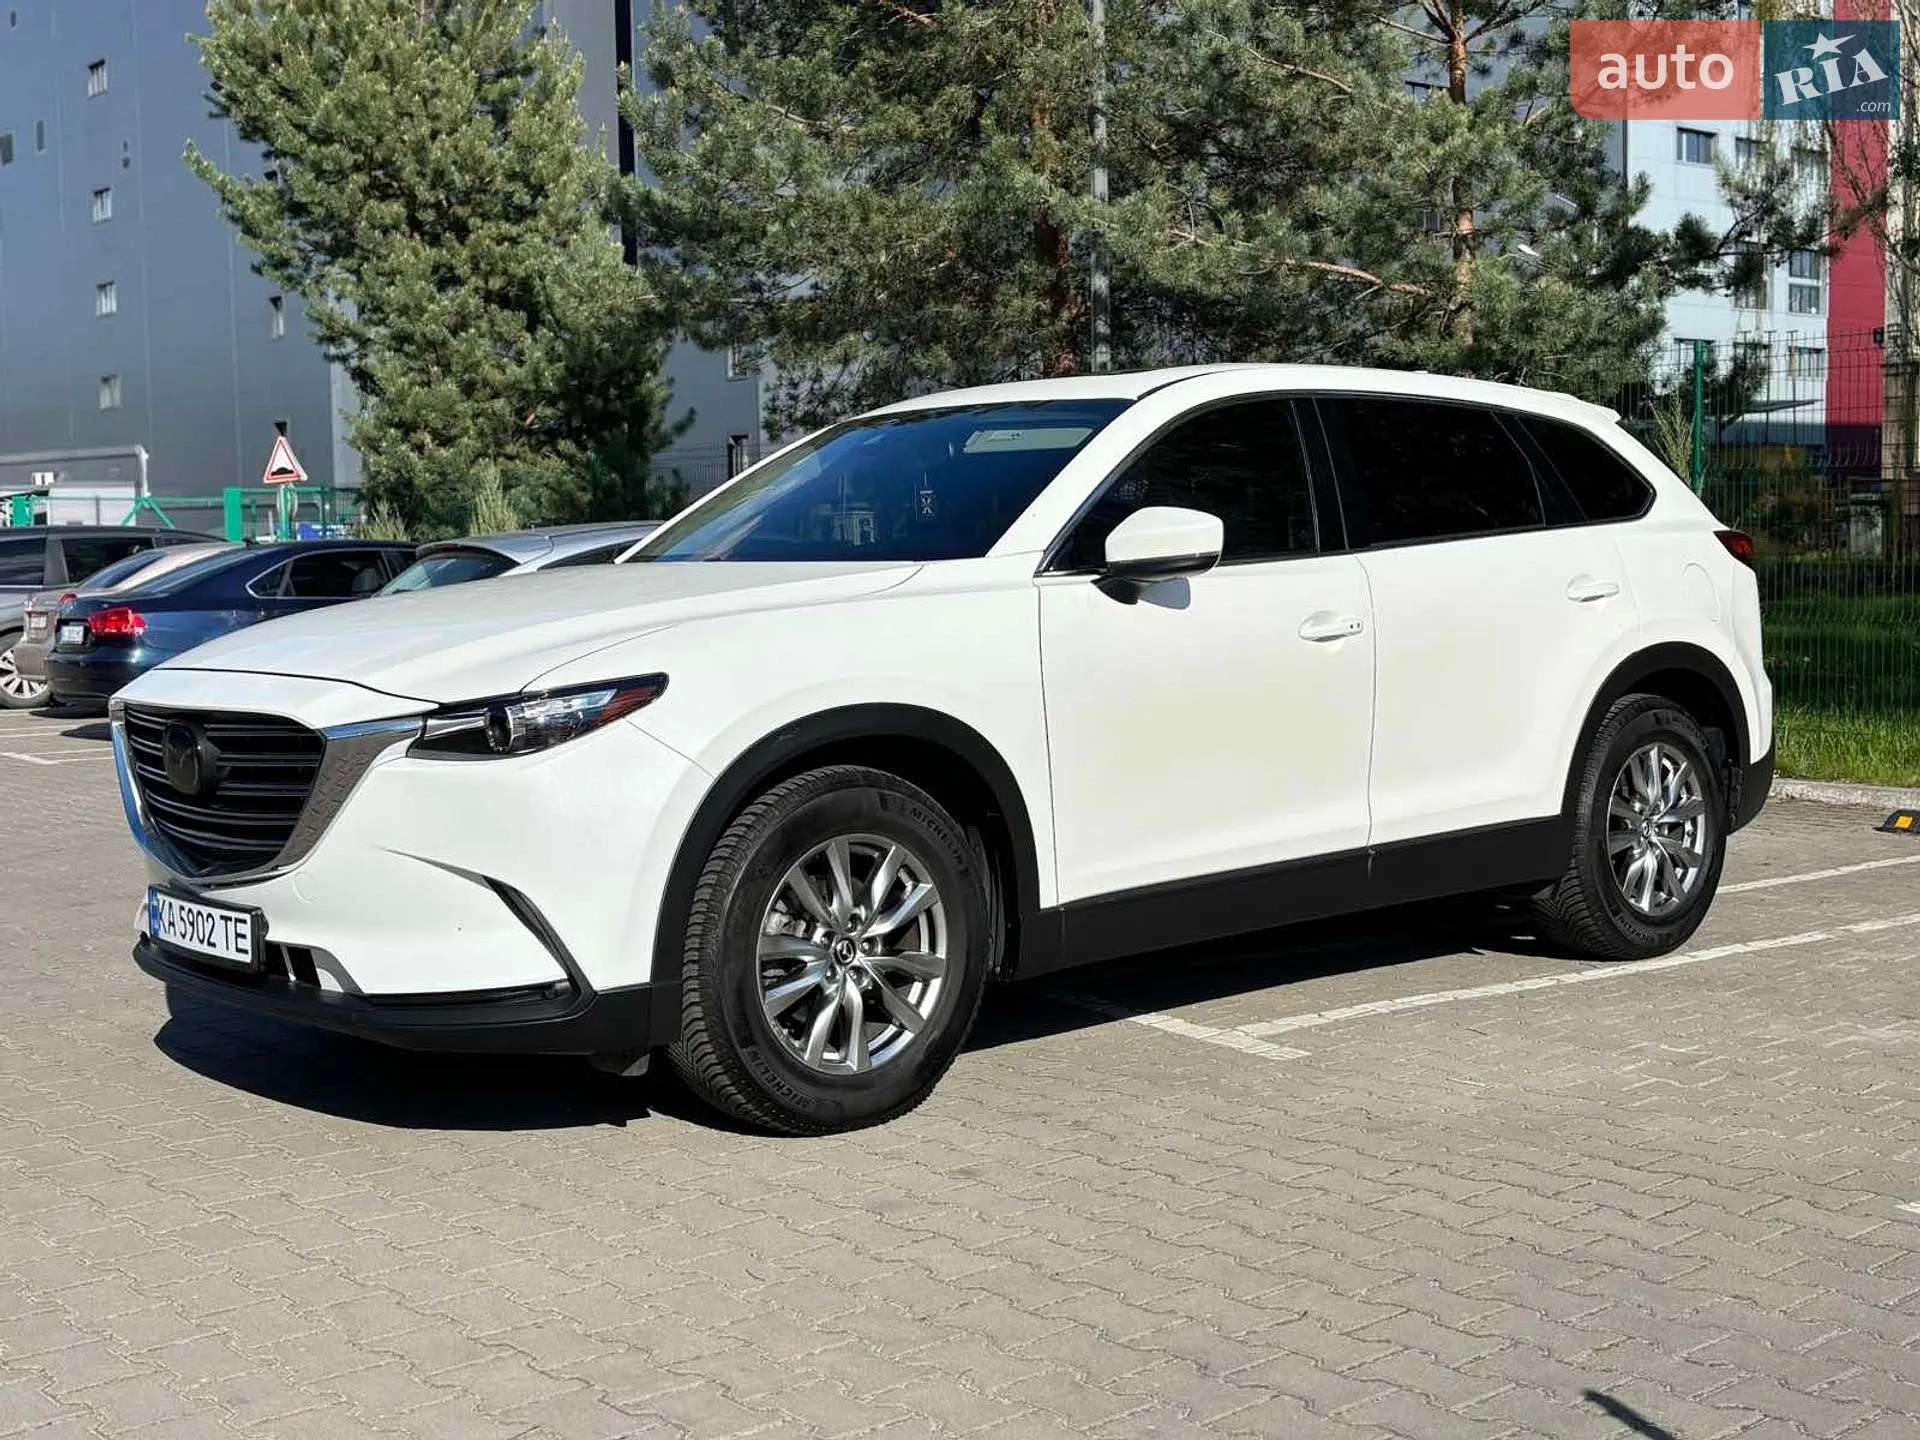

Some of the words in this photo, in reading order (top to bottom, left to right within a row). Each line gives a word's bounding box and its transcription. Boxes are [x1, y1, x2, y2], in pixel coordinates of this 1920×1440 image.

[158, 899, 176, 937] KA
[179, 905, 217, 948] 5902
[220, 914, 249, 955] TE
[747, 1051, 813, 1109] MICHELIN
